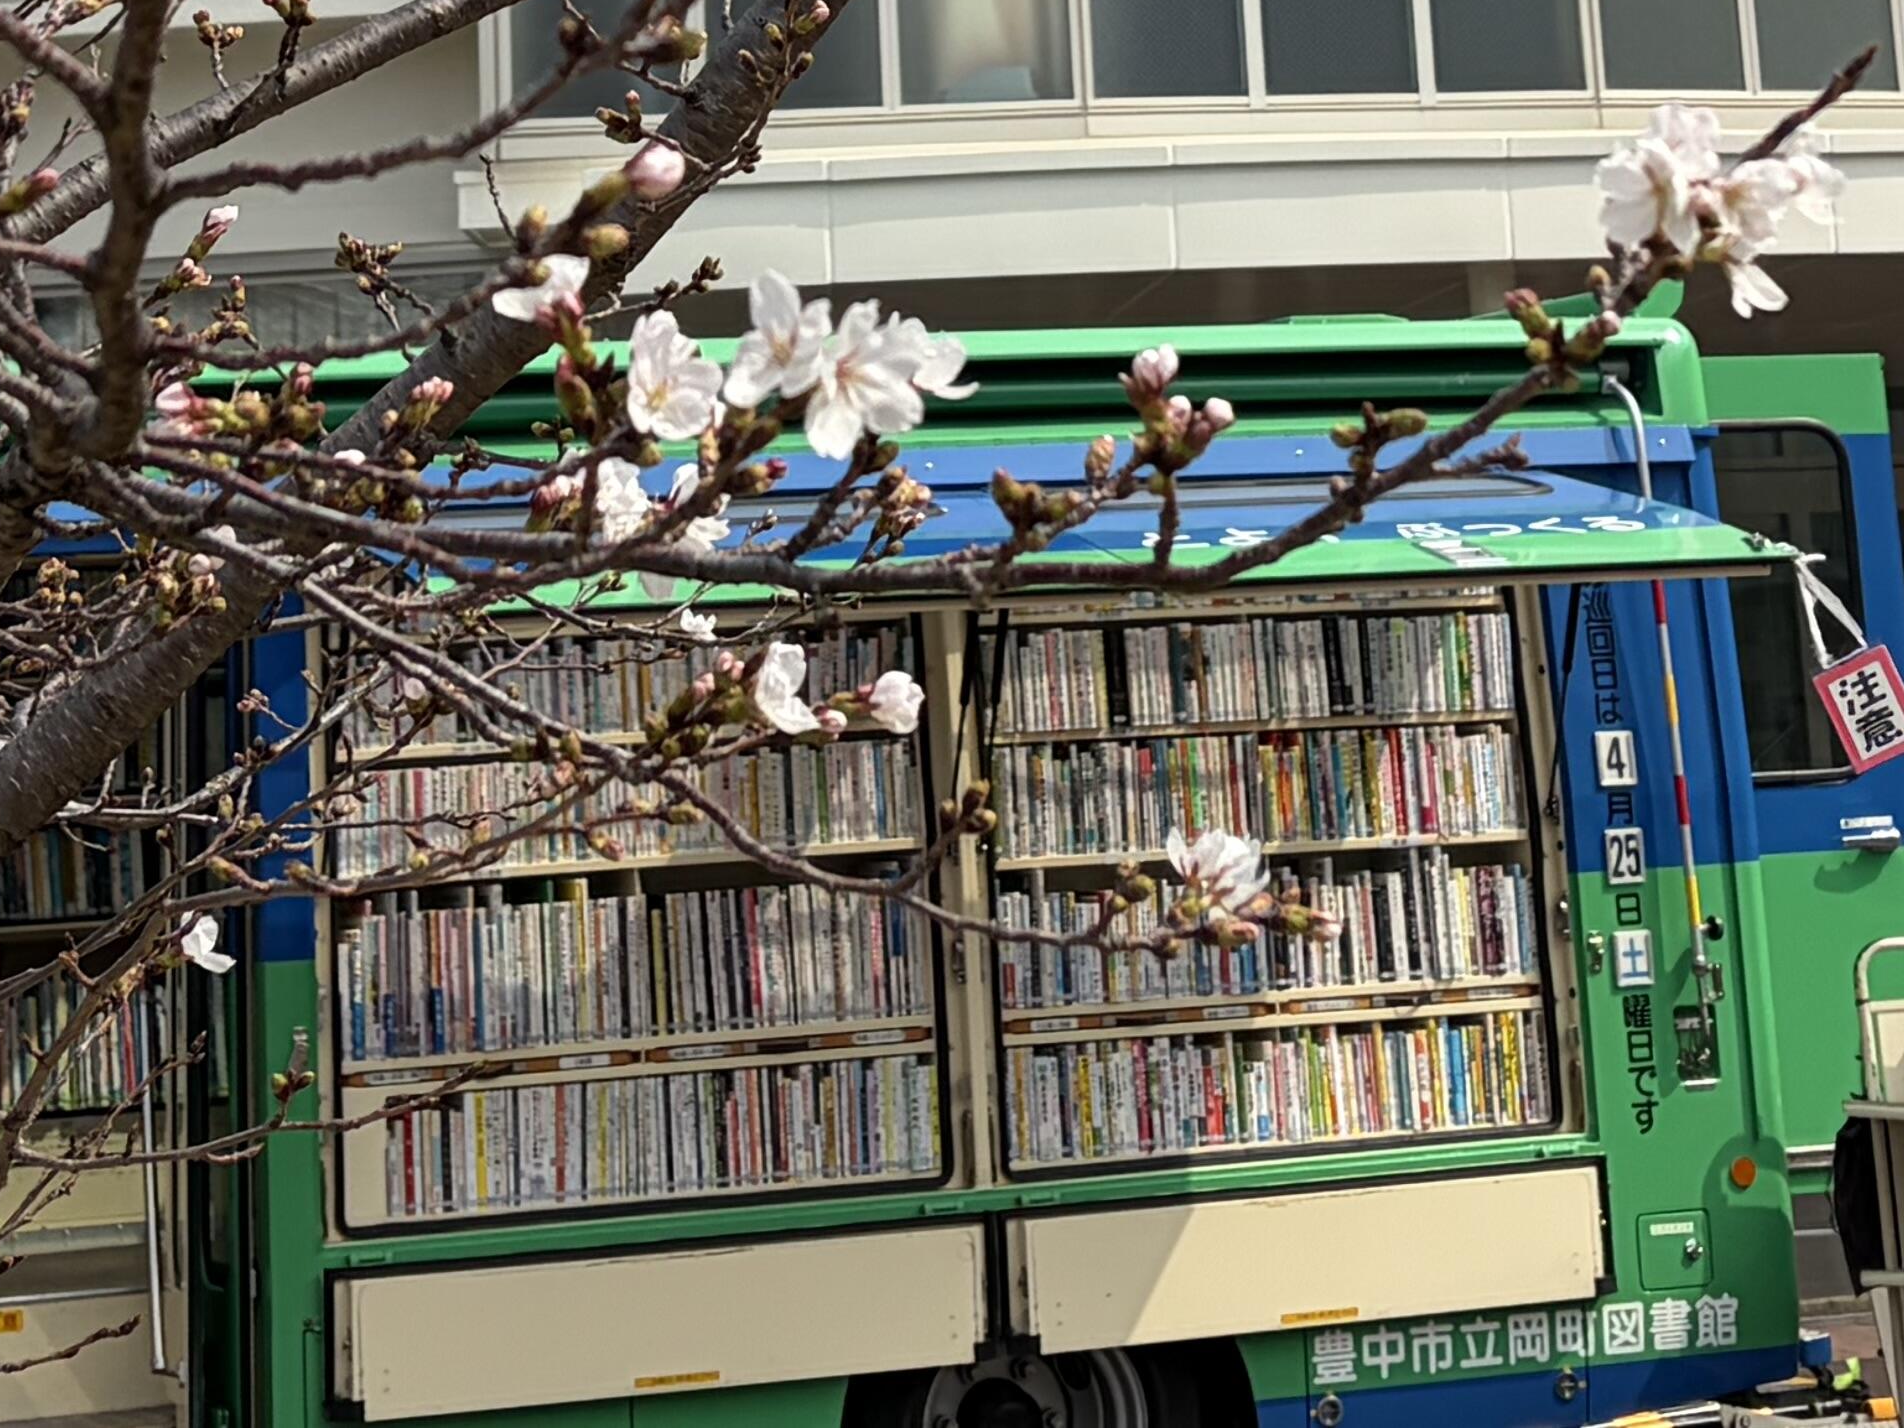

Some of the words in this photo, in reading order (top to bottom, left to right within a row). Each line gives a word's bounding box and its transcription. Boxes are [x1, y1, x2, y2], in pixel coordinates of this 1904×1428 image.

[1838, 670, 1903, 752] 注意
[1312, 1292, 1739, 1386] 豊中市立岡町図書館
